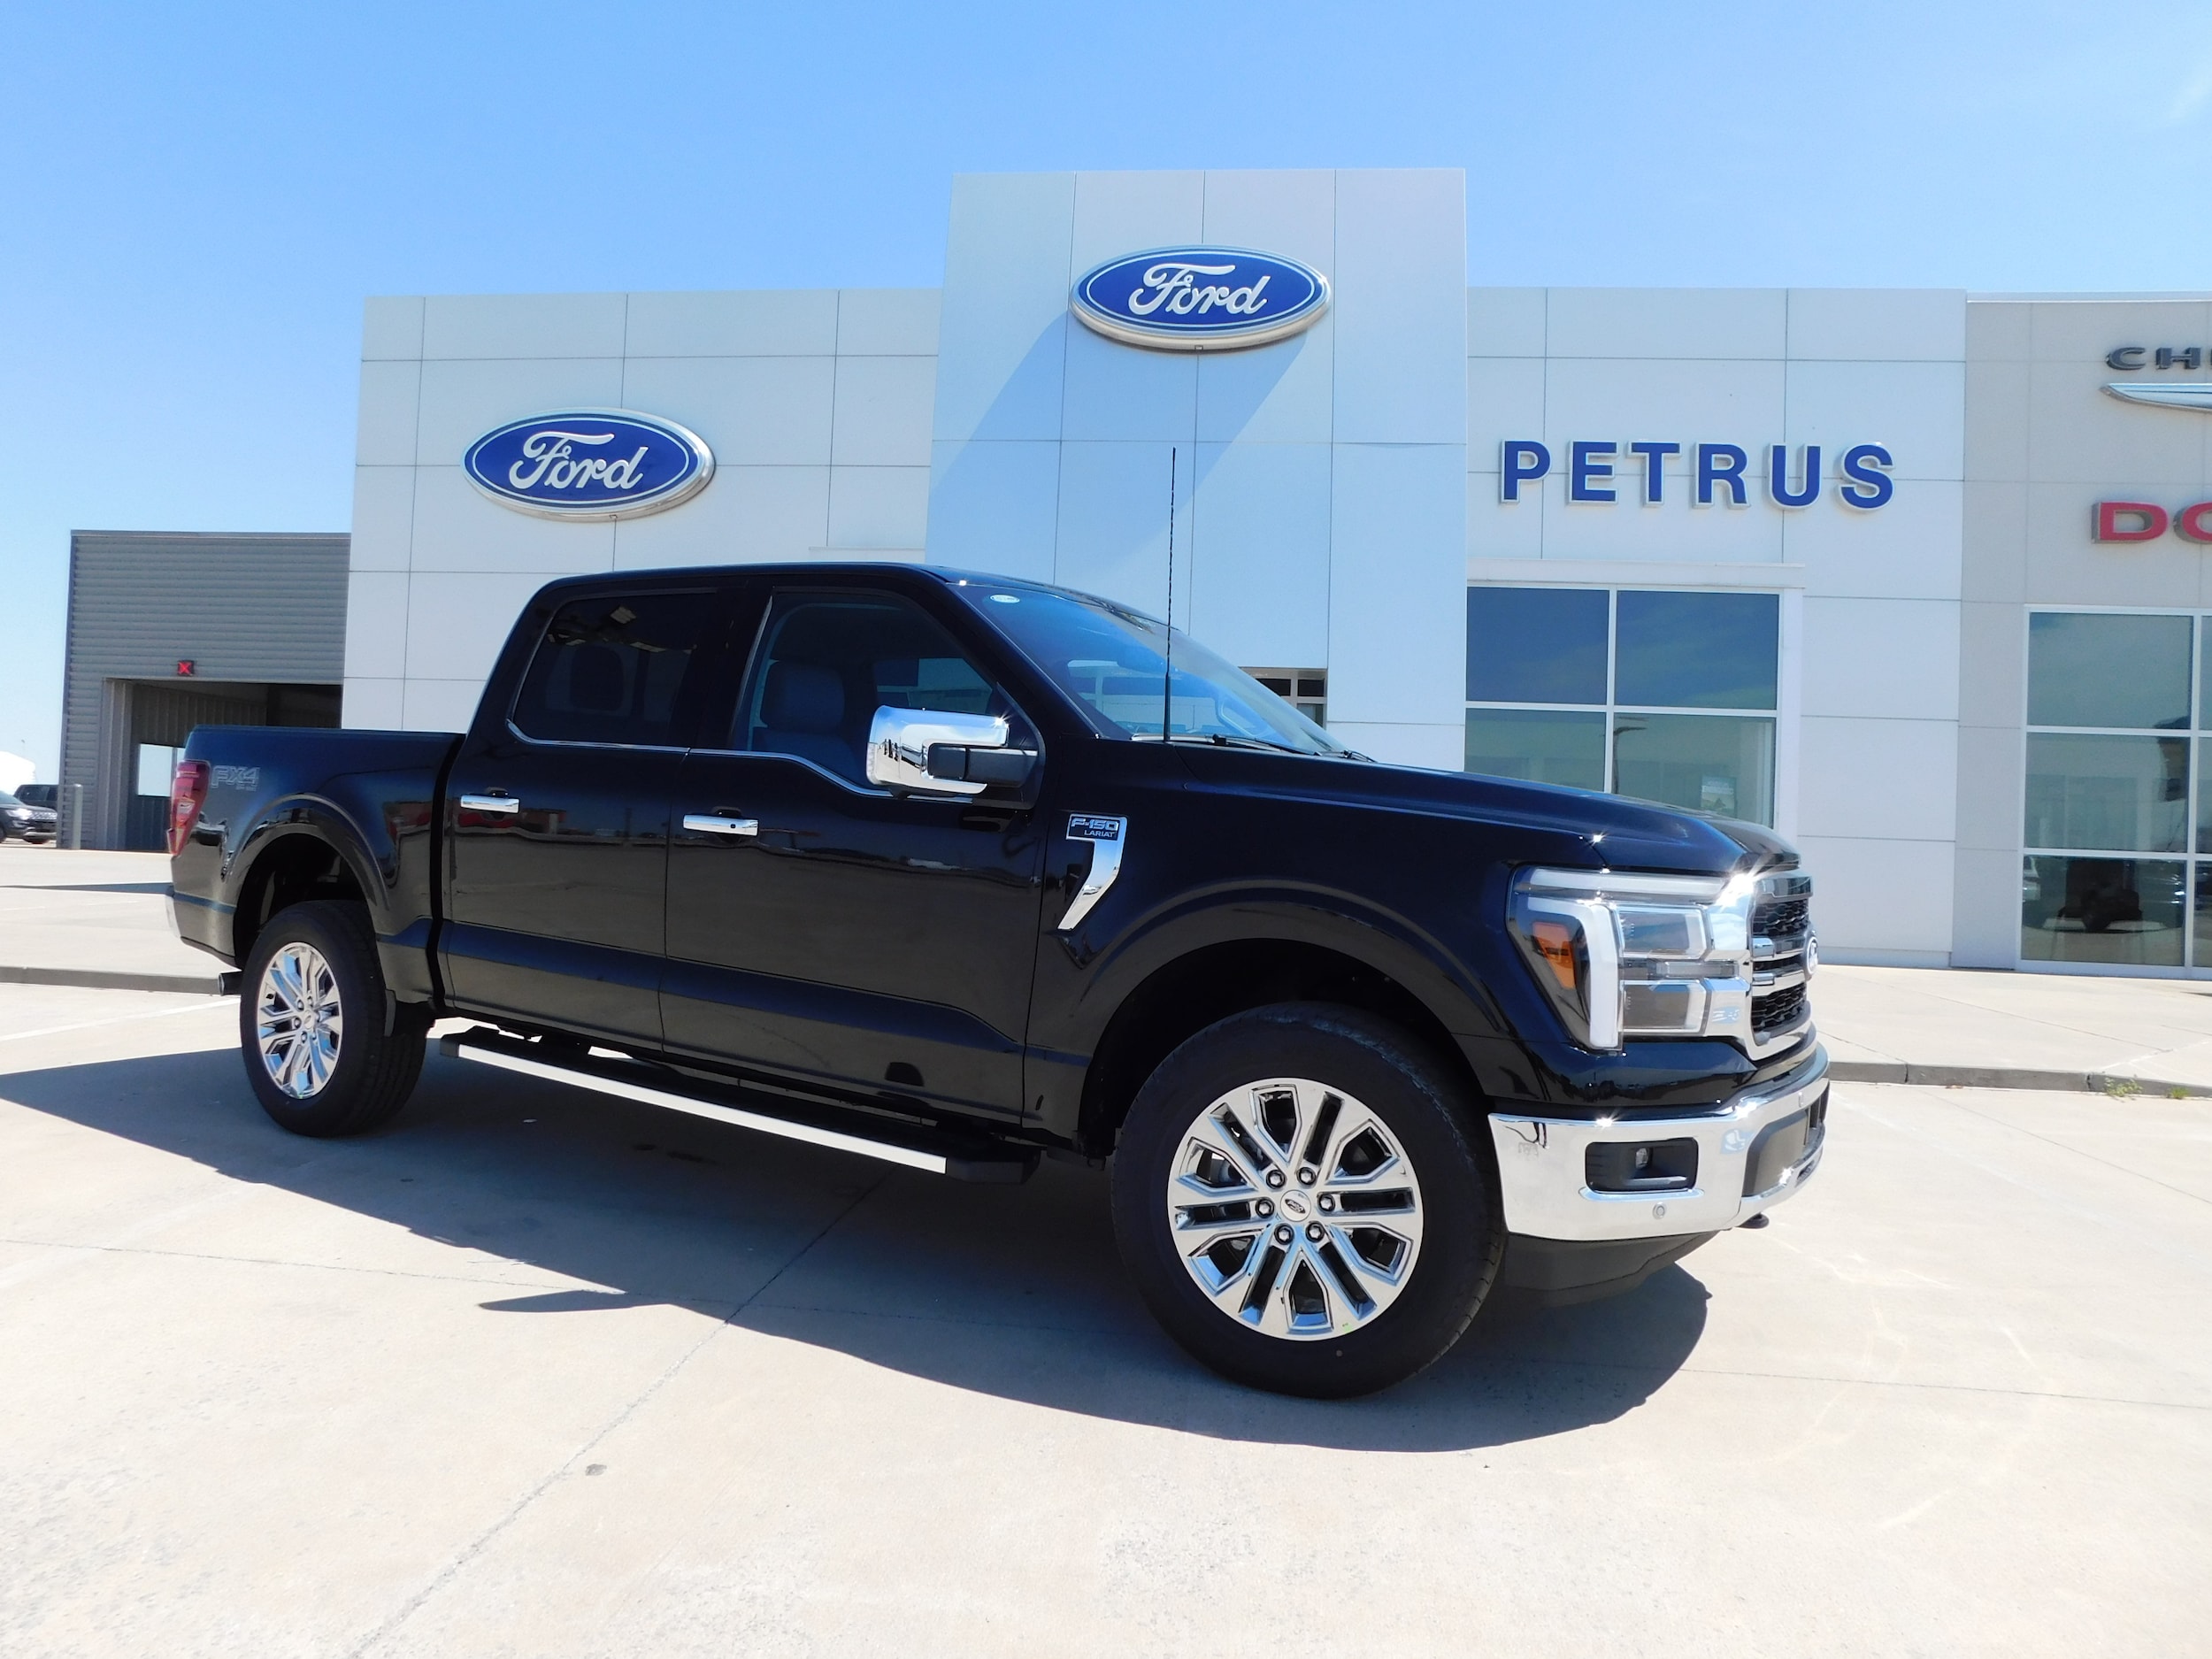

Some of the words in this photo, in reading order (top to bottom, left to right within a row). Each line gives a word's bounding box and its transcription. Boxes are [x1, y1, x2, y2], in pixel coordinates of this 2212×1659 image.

[1128, 263, 1270, 316] Ford
[2106, 346, 2212, 370] CH
[509, 431, 649, 489] Ford
[1502, 440, 1895, 511] PETRUS
[211, 764, 260, 788] FX4
[1071, 818, 1118, 831] F-150
[1084, 829, 1115, 838] LARIAT
